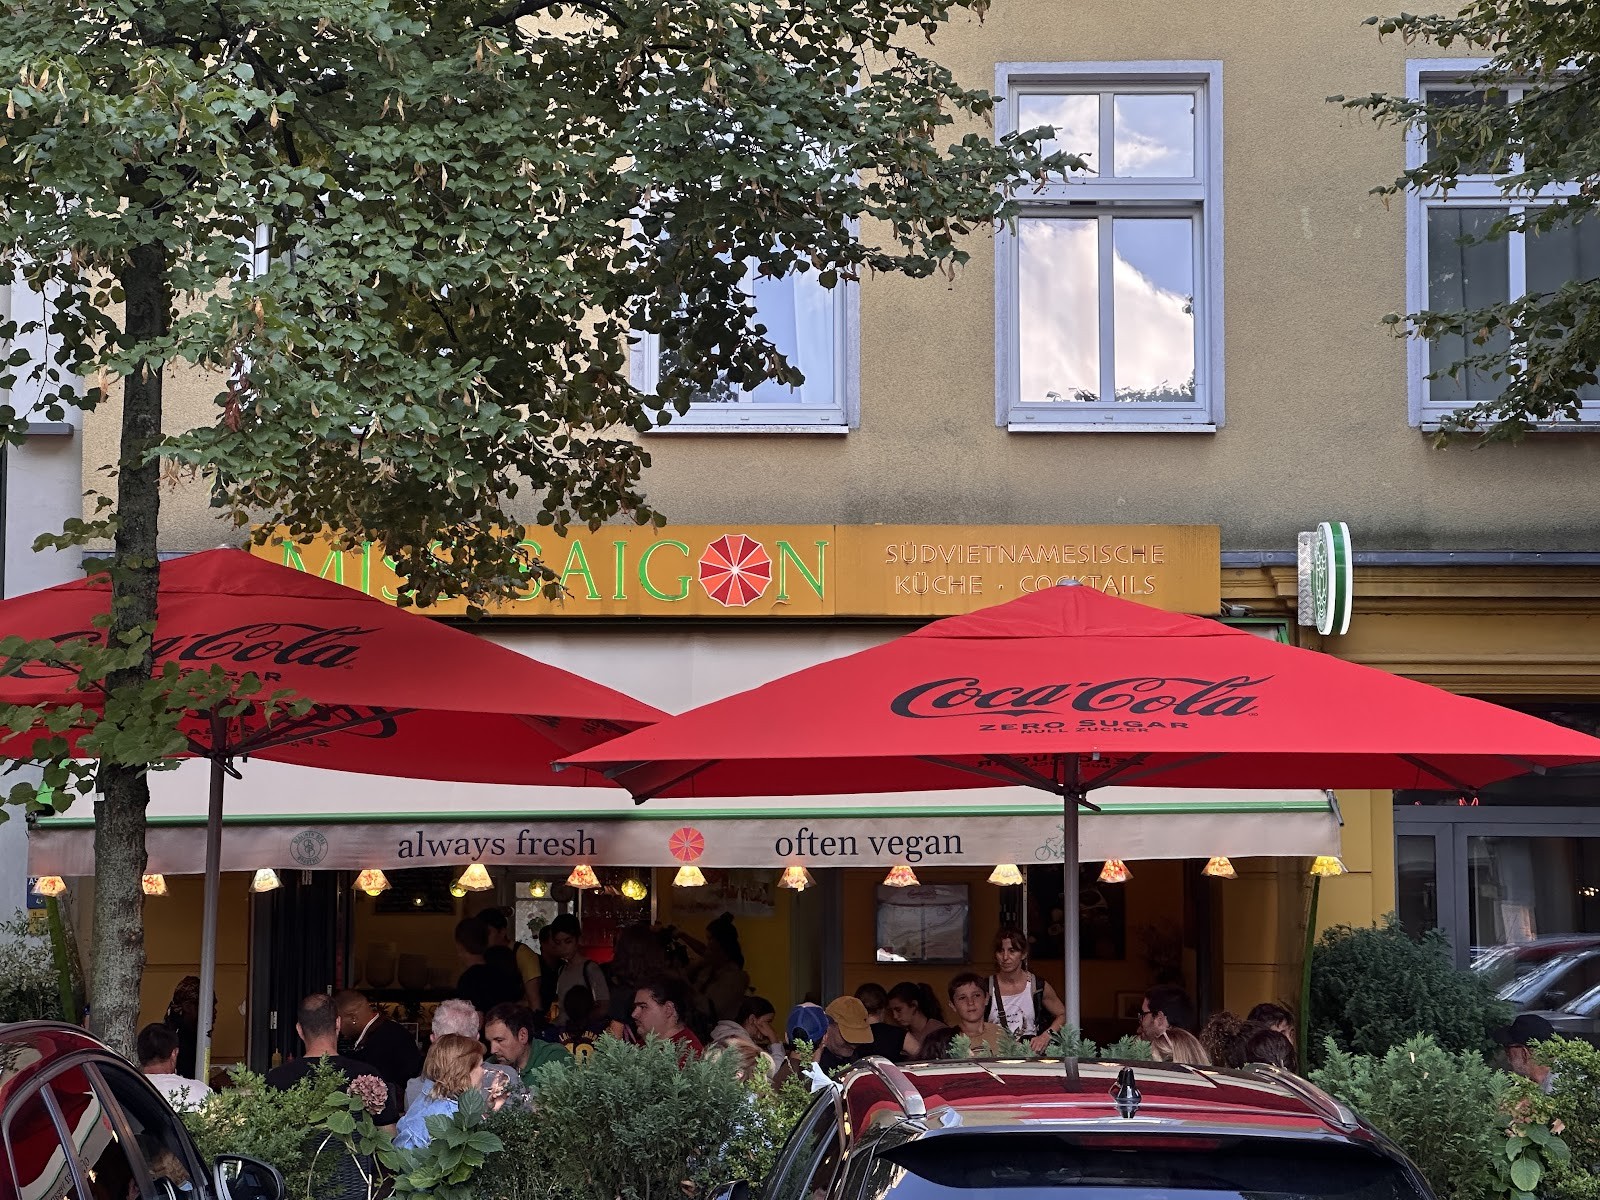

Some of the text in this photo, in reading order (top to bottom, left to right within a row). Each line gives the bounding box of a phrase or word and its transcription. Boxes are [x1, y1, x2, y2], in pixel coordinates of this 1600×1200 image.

[885, 541, 1165, 565] SÜDVIETNAMESISCHE
[895, 571, 983, 595] KÜCHE
[979, 719, 1189, 731] ZERO SUGAR
[398, 828, 598, 861] always fresh
[775, 827, 964, 863] often vegan
